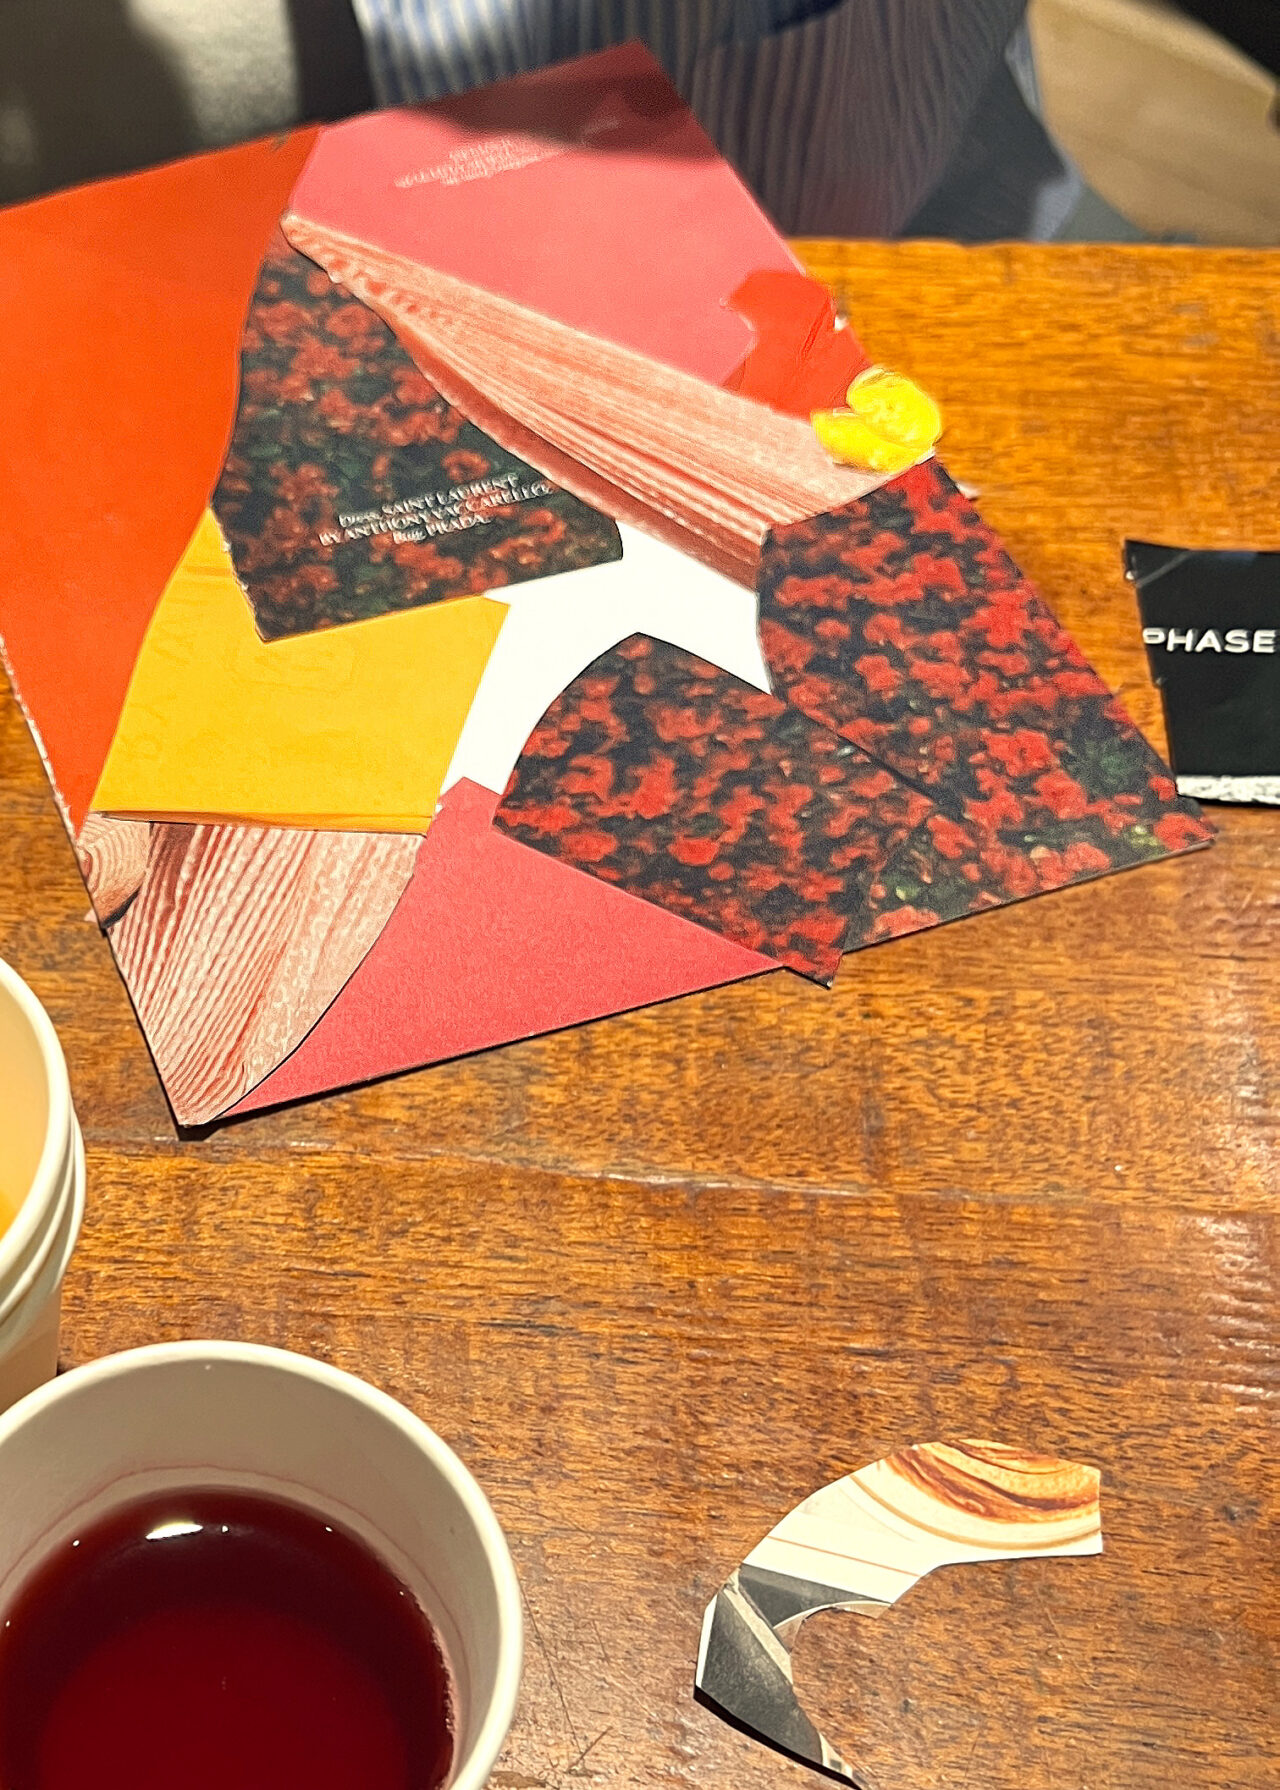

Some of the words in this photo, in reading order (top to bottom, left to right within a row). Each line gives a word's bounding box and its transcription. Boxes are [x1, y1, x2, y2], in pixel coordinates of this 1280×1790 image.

[381, 493, 435, 515] SAINT
[436, 473, 519, 505] LAURENT
[319, 528, 342, 546] BY
[344, 509, 430, 540] ANTHONY
[1141, 627, 1277, 654] PHASE
